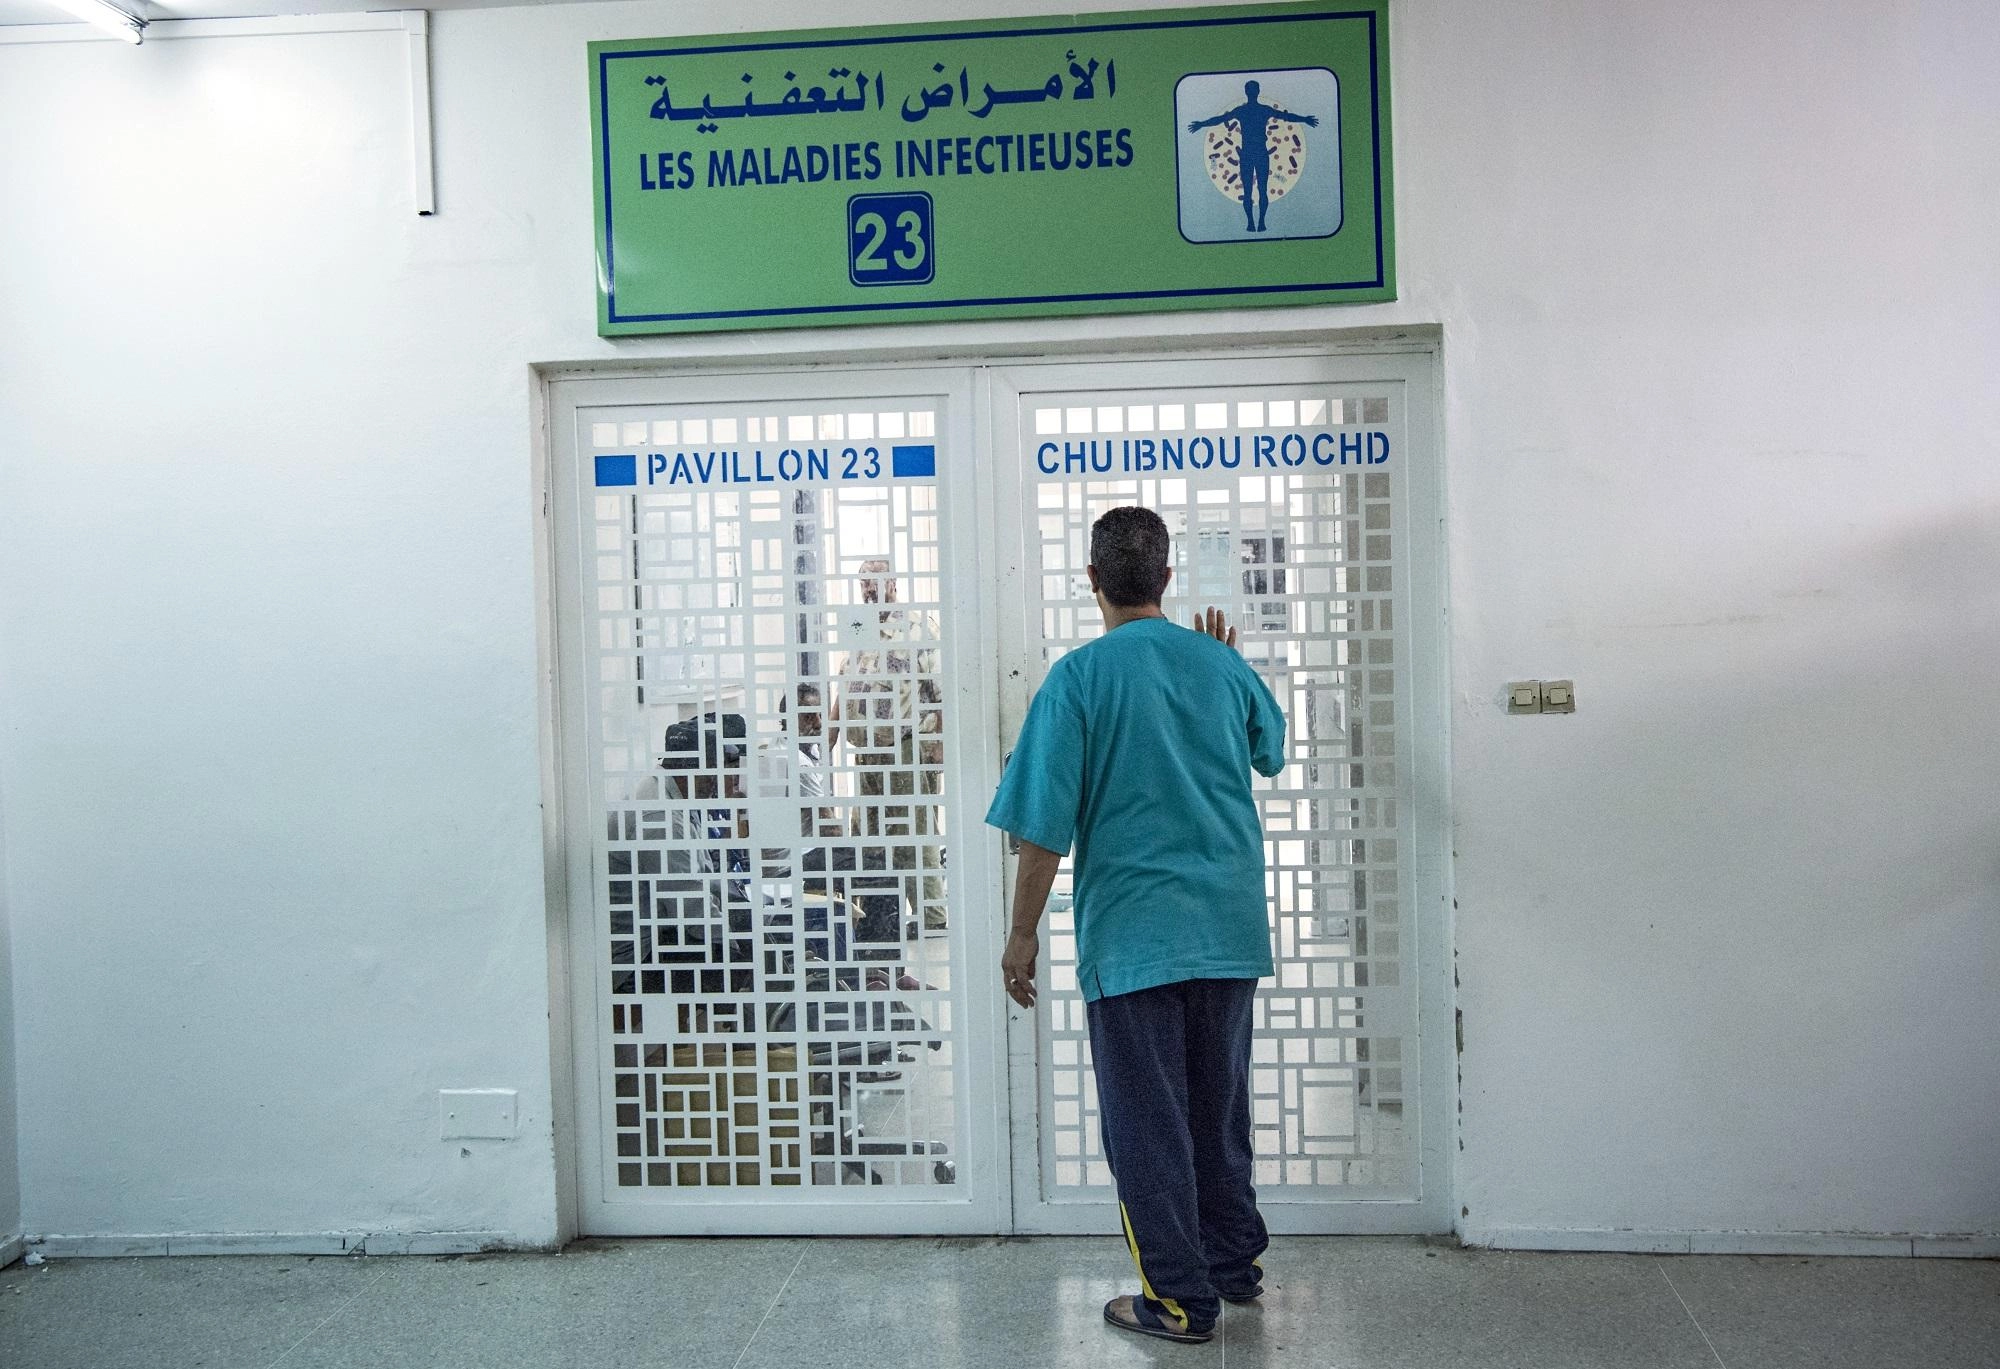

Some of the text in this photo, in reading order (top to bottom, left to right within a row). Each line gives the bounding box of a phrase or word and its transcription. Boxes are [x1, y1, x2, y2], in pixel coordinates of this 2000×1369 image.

[643, 49, 1117, 134] الأمراض التعفنية
[640, 128, 1135, 192] LES MALADIES INFECTIEUSES
[854, 211, 926, 271] 23
[646, 446, 882, 487] PAVILLON 23
[1036, 431, 1391, 476] CHU IBNOU ROCHD
